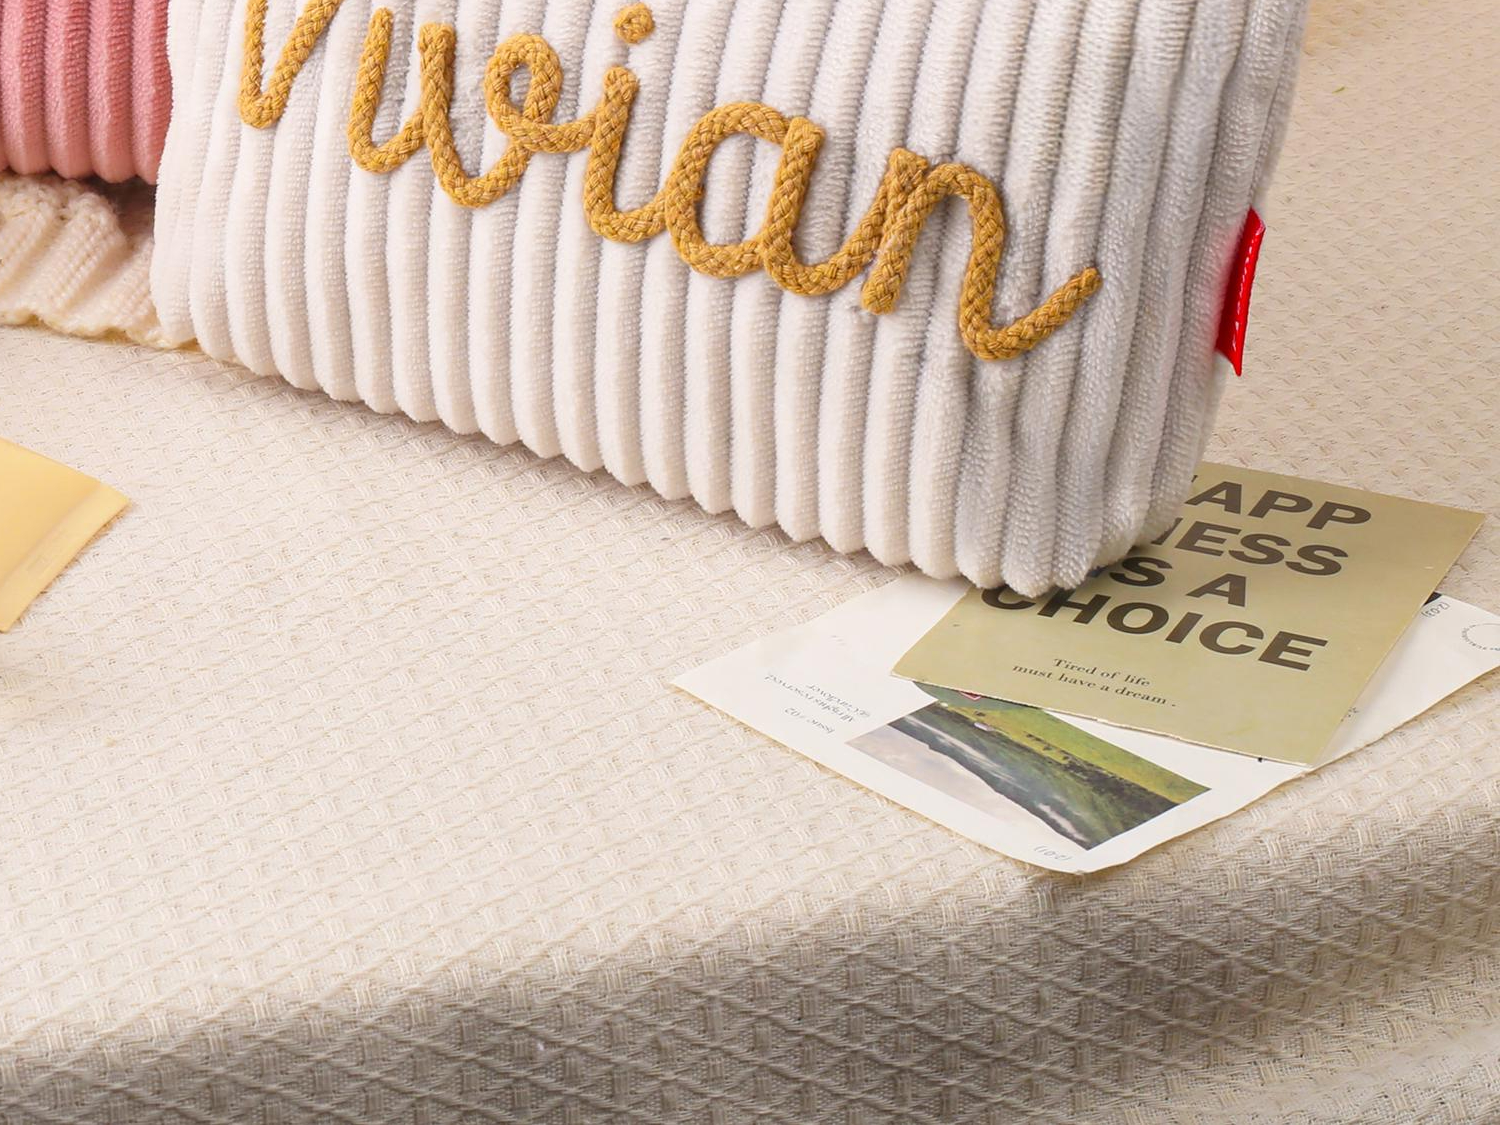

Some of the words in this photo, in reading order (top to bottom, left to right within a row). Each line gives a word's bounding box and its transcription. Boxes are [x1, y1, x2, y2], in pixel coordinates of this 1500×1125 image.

[1185, 475, 1372, 530] APP
[1186, 573, 1246, 608] A
[1012, 664, 1053, 680] must
[1058, 673, 1097, 689] have
[1100, 685, 1111, 693] a
[1053, 658, 1097, 676] Tired
[1101, 670, 1121, 680] of
[1124, 674, 1151, 688] life
